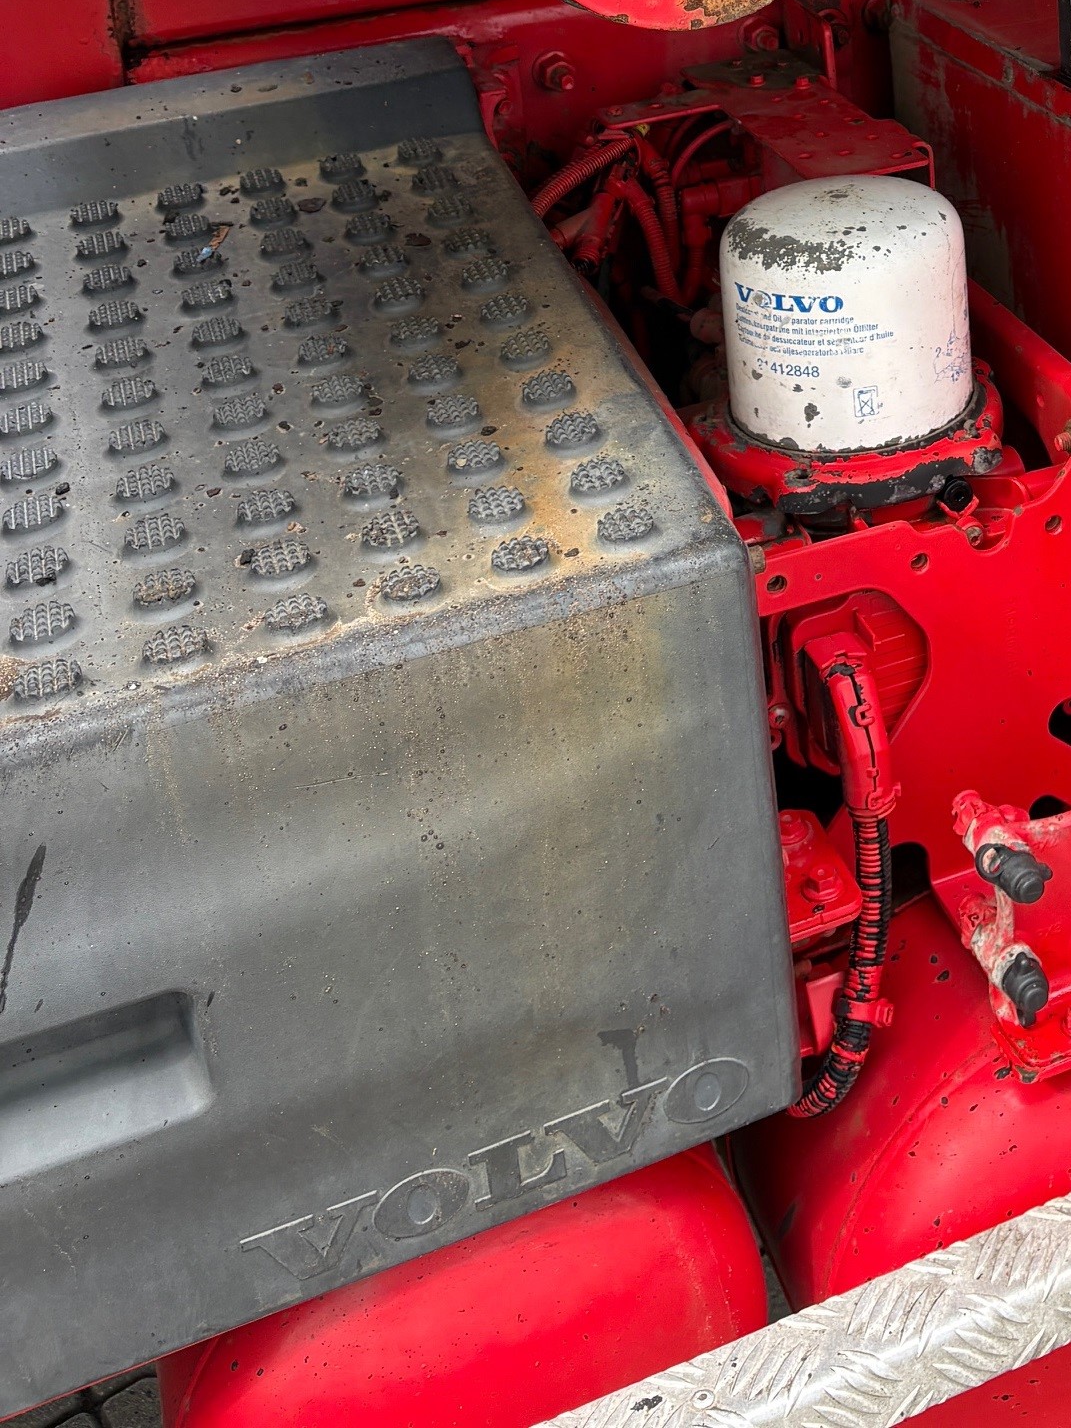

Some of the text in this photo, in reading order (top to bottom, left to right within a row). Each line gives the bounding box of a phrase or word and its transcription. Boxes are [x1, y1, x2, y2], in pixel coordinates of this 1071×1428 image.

[734, 282, 844, 313] VOLVO
[786, 316, 818, 327] parator
[791, 328, 804, 336] mit
[817, 337, 826, 346] et
[239, 1056, 750, 1281] VOLVO
